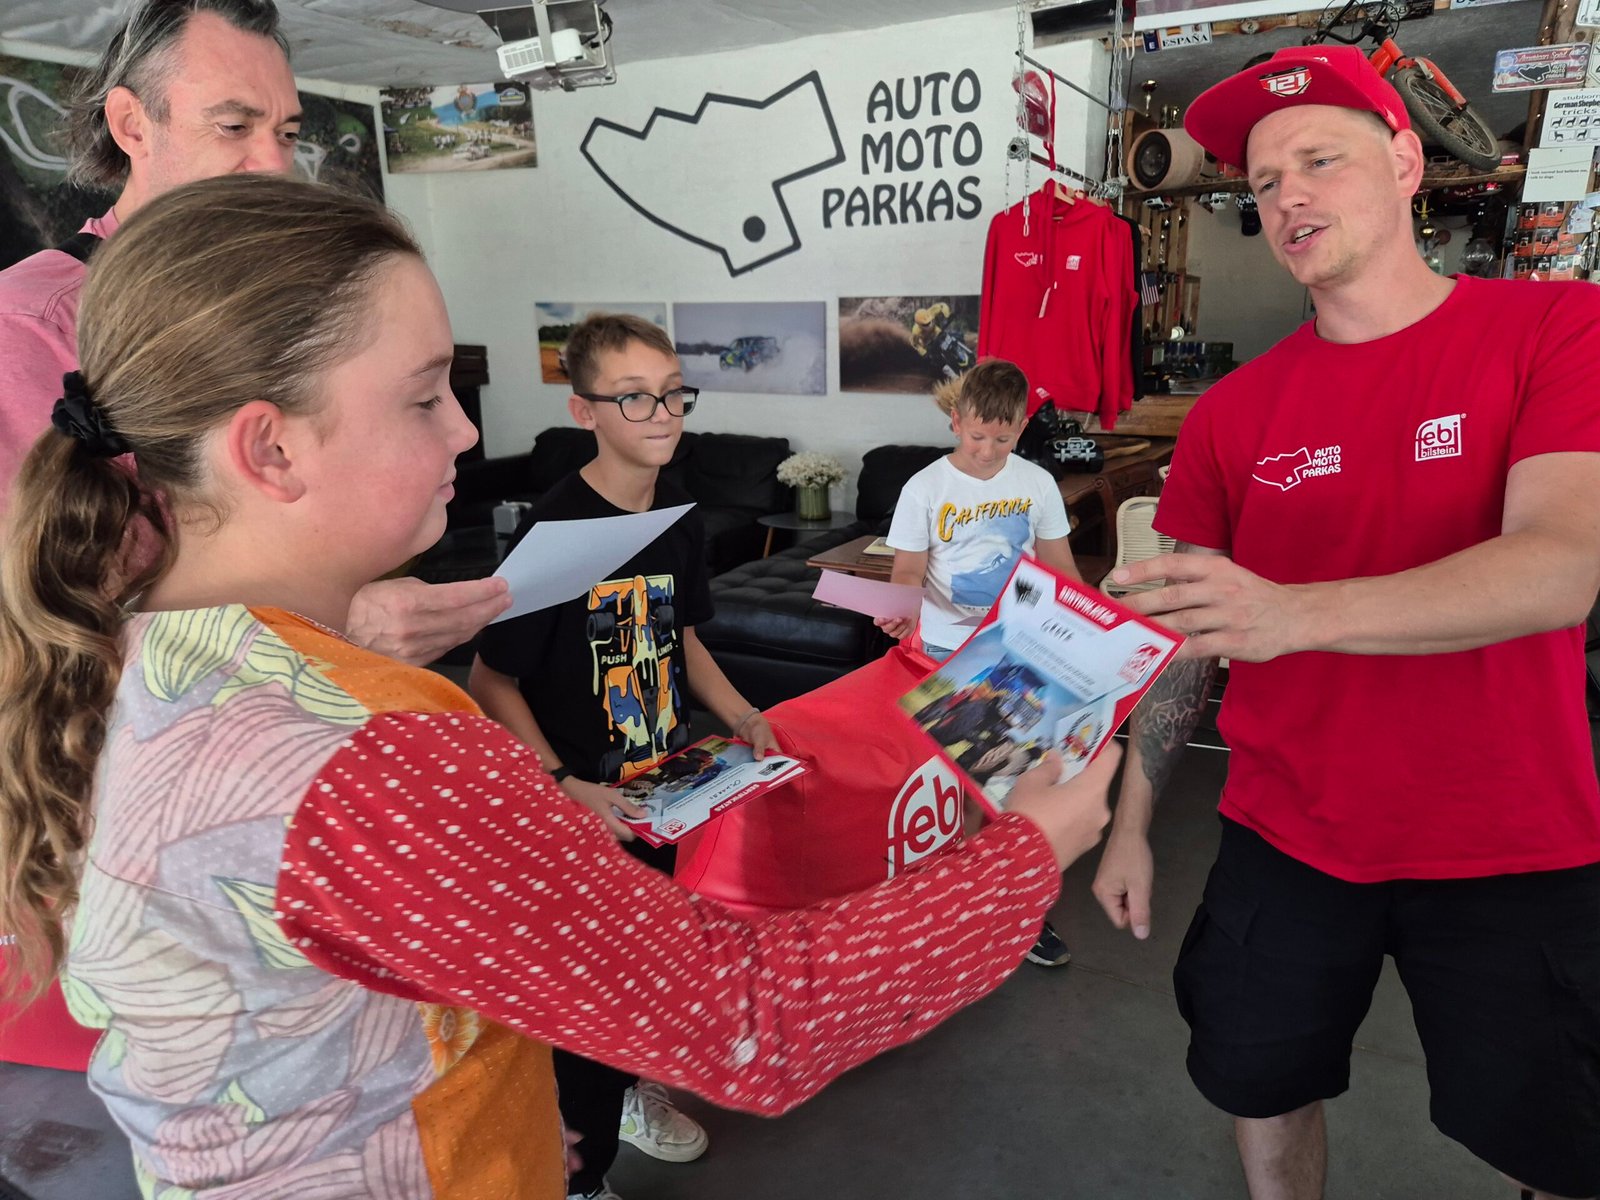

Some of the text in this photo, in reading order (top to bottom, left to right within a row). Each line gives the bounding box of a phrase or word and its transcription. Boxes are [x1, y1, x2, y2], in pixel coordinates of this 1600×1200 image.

[1162, 33, 1208, 47] ESPAÑA
[1267, 73, 1306, 92] 121
[867, 68, 982, 123] AUTO
[1554, 101, 1578, 109] German
[861, 121, 983, 175] MOTO
[822, 175, 983, 229] PARKAS
[1416, 420, 1459, 447] febi
[1314, 445, 1341, 458] AUTO
[1421, 446, 1456, 458] bilstein
[1312, 454, 1341, 467] MOTO
[1302, 463, 1341, 478] PARKAS
[938, 498, 1033, 542] CALIFORNIA
[601, 653, 628, 665] PUSH
